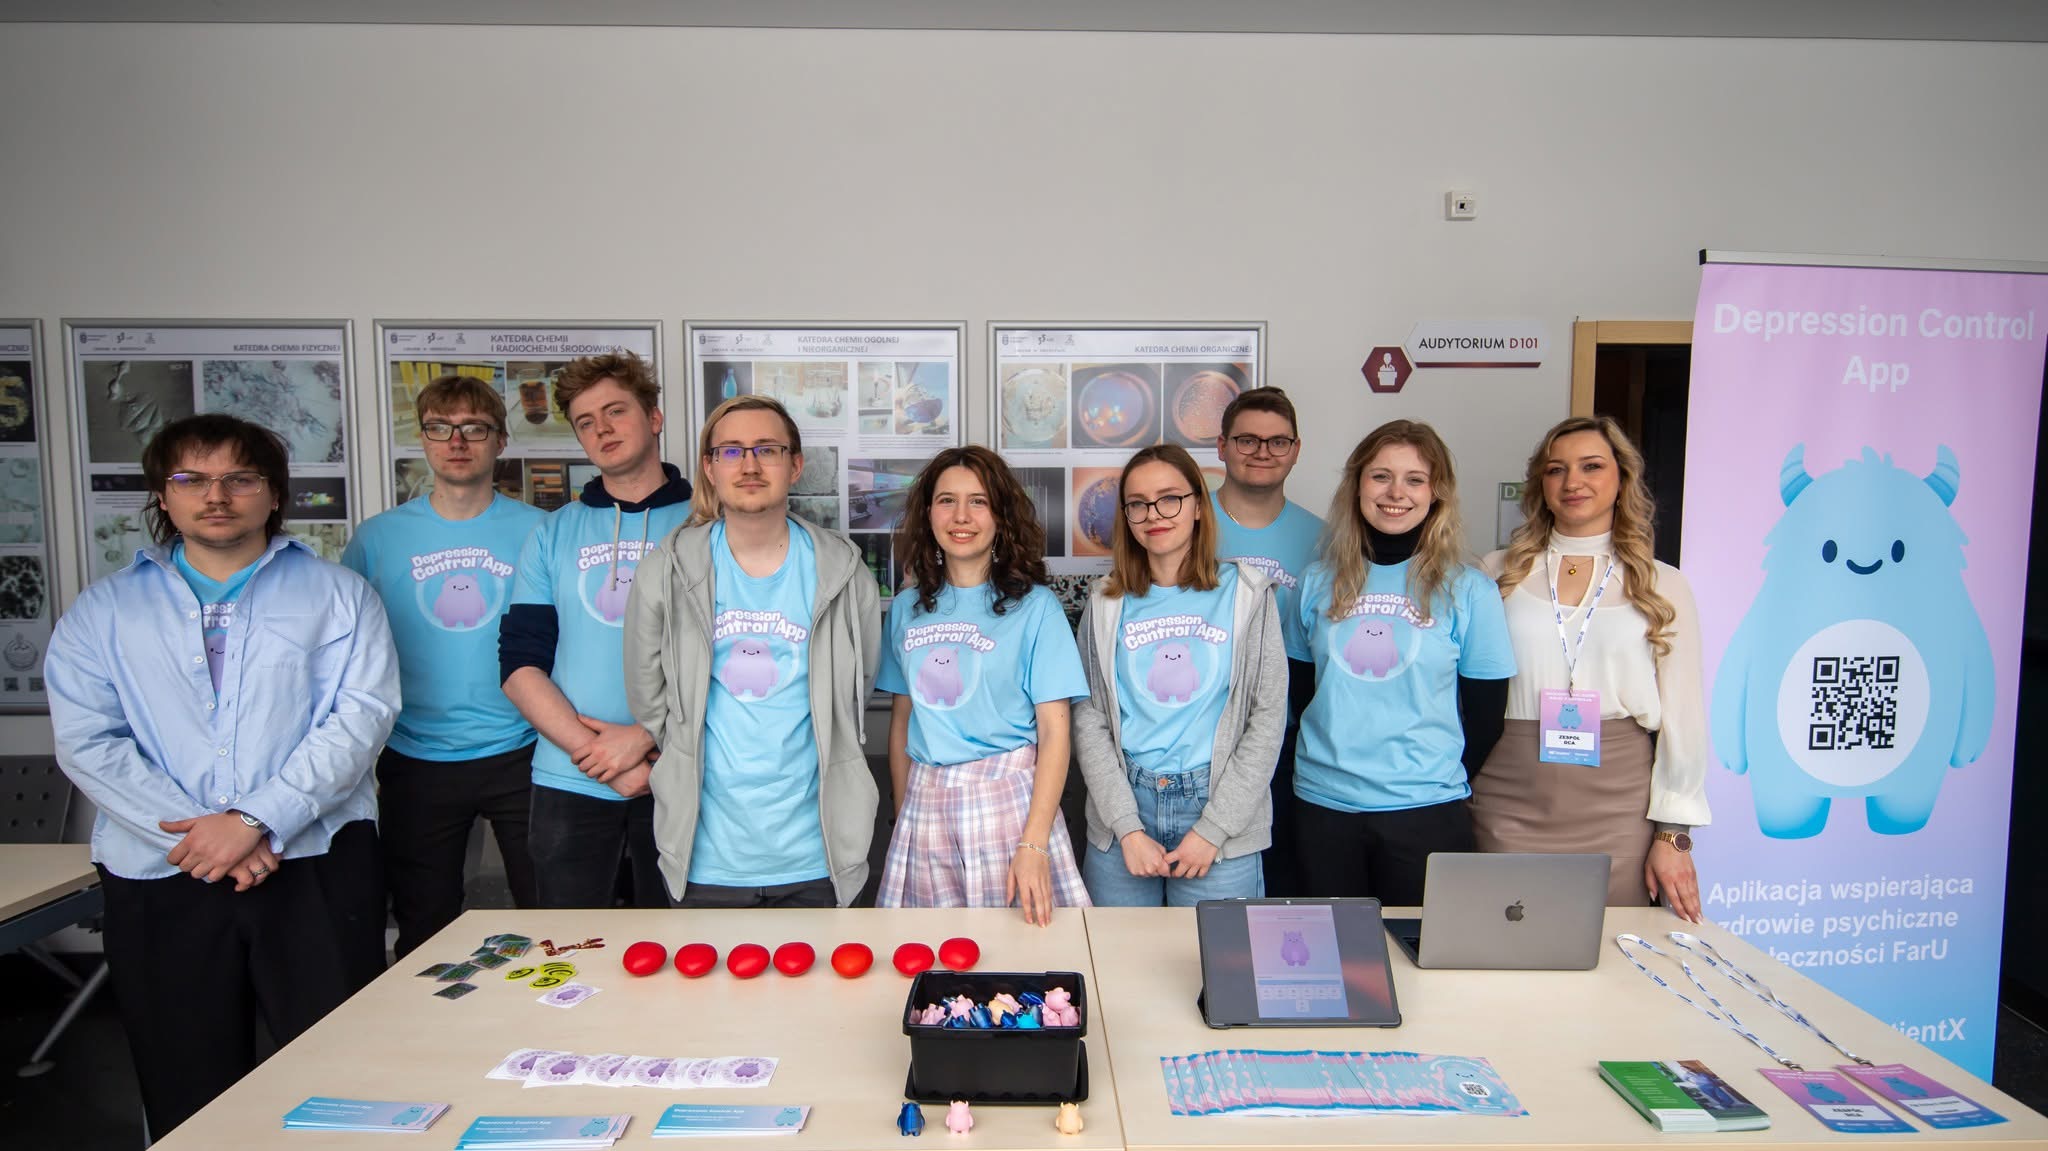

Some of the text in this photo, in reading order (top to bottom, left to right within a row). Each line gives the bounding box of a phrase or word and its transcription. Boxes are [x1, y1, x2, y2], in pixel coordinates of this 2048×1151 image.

[1713, 304, 2035, 341] Depression Control
[233, 344, 268, 352] KATEDRA
[490, 335, 569, 343] KATEDRA CHEMII
[496, 344, 558, 352] RADIOCHEMII
[560, 343, 623, 353] ŚRODOWISKA
[797, 335, 832, 343] KATEDRA
[835, 336, 862, 344] CHEMII
[1134, 345, 1169, 353] KATEDRA
[1171, 345, 1199, 353] CHEMII
[1418, 337, 1538, 349] AUDYTORIUM D101
[1841, 355, 1910, 393] App
[1504, 485, 1517, 498] D
[411, 547, 489, 567] Depression
[412, 556, 514, 580] Control App
[774, 618, 808, 642] App
[907, 622, 978, 638] Depression
[1125, 615, 1202, 635] Depression
[904, 632, 996, 652] Control App
[1125, 624, 1228, 650] Control App
[1706, 874, 1974, 909] Aplikacja wspierająca
[1822, 908, 1959, 939] psychiczne
[1893, 938, 1949, 963] FarU
